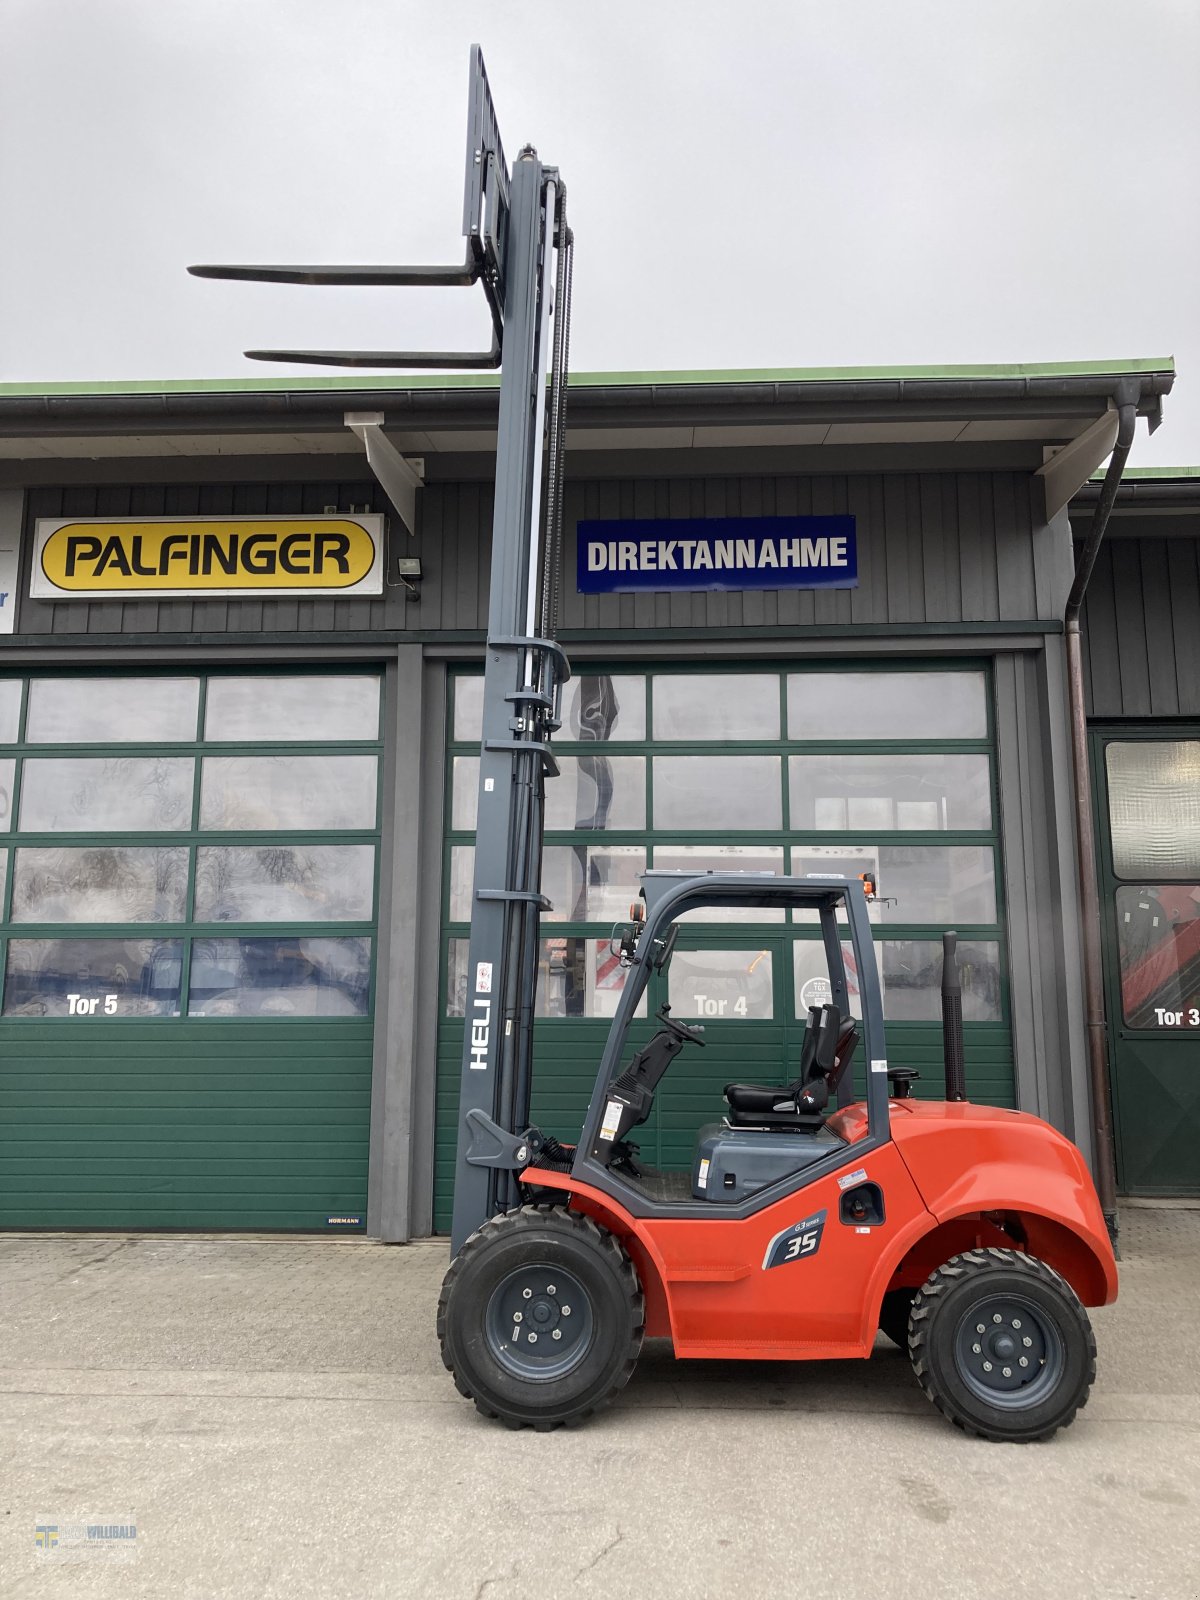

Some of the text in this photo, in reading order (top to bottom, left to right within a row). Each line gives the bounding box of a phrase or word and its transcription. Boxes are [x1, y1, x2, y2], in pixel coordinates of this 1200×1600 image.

[65, 533, 351, 576] PALFINGER
[587, 537, 848, 572] DIREKTANNAHME
[66, 994, 118, 1015] Tor 5
[693, 994, 748, 1016] Tor 4
[1154, 1008, 1200, 1026] Tor 3
[470, 999, 491, 1070] HELI
[784, 1230, 818, 1260] 35
